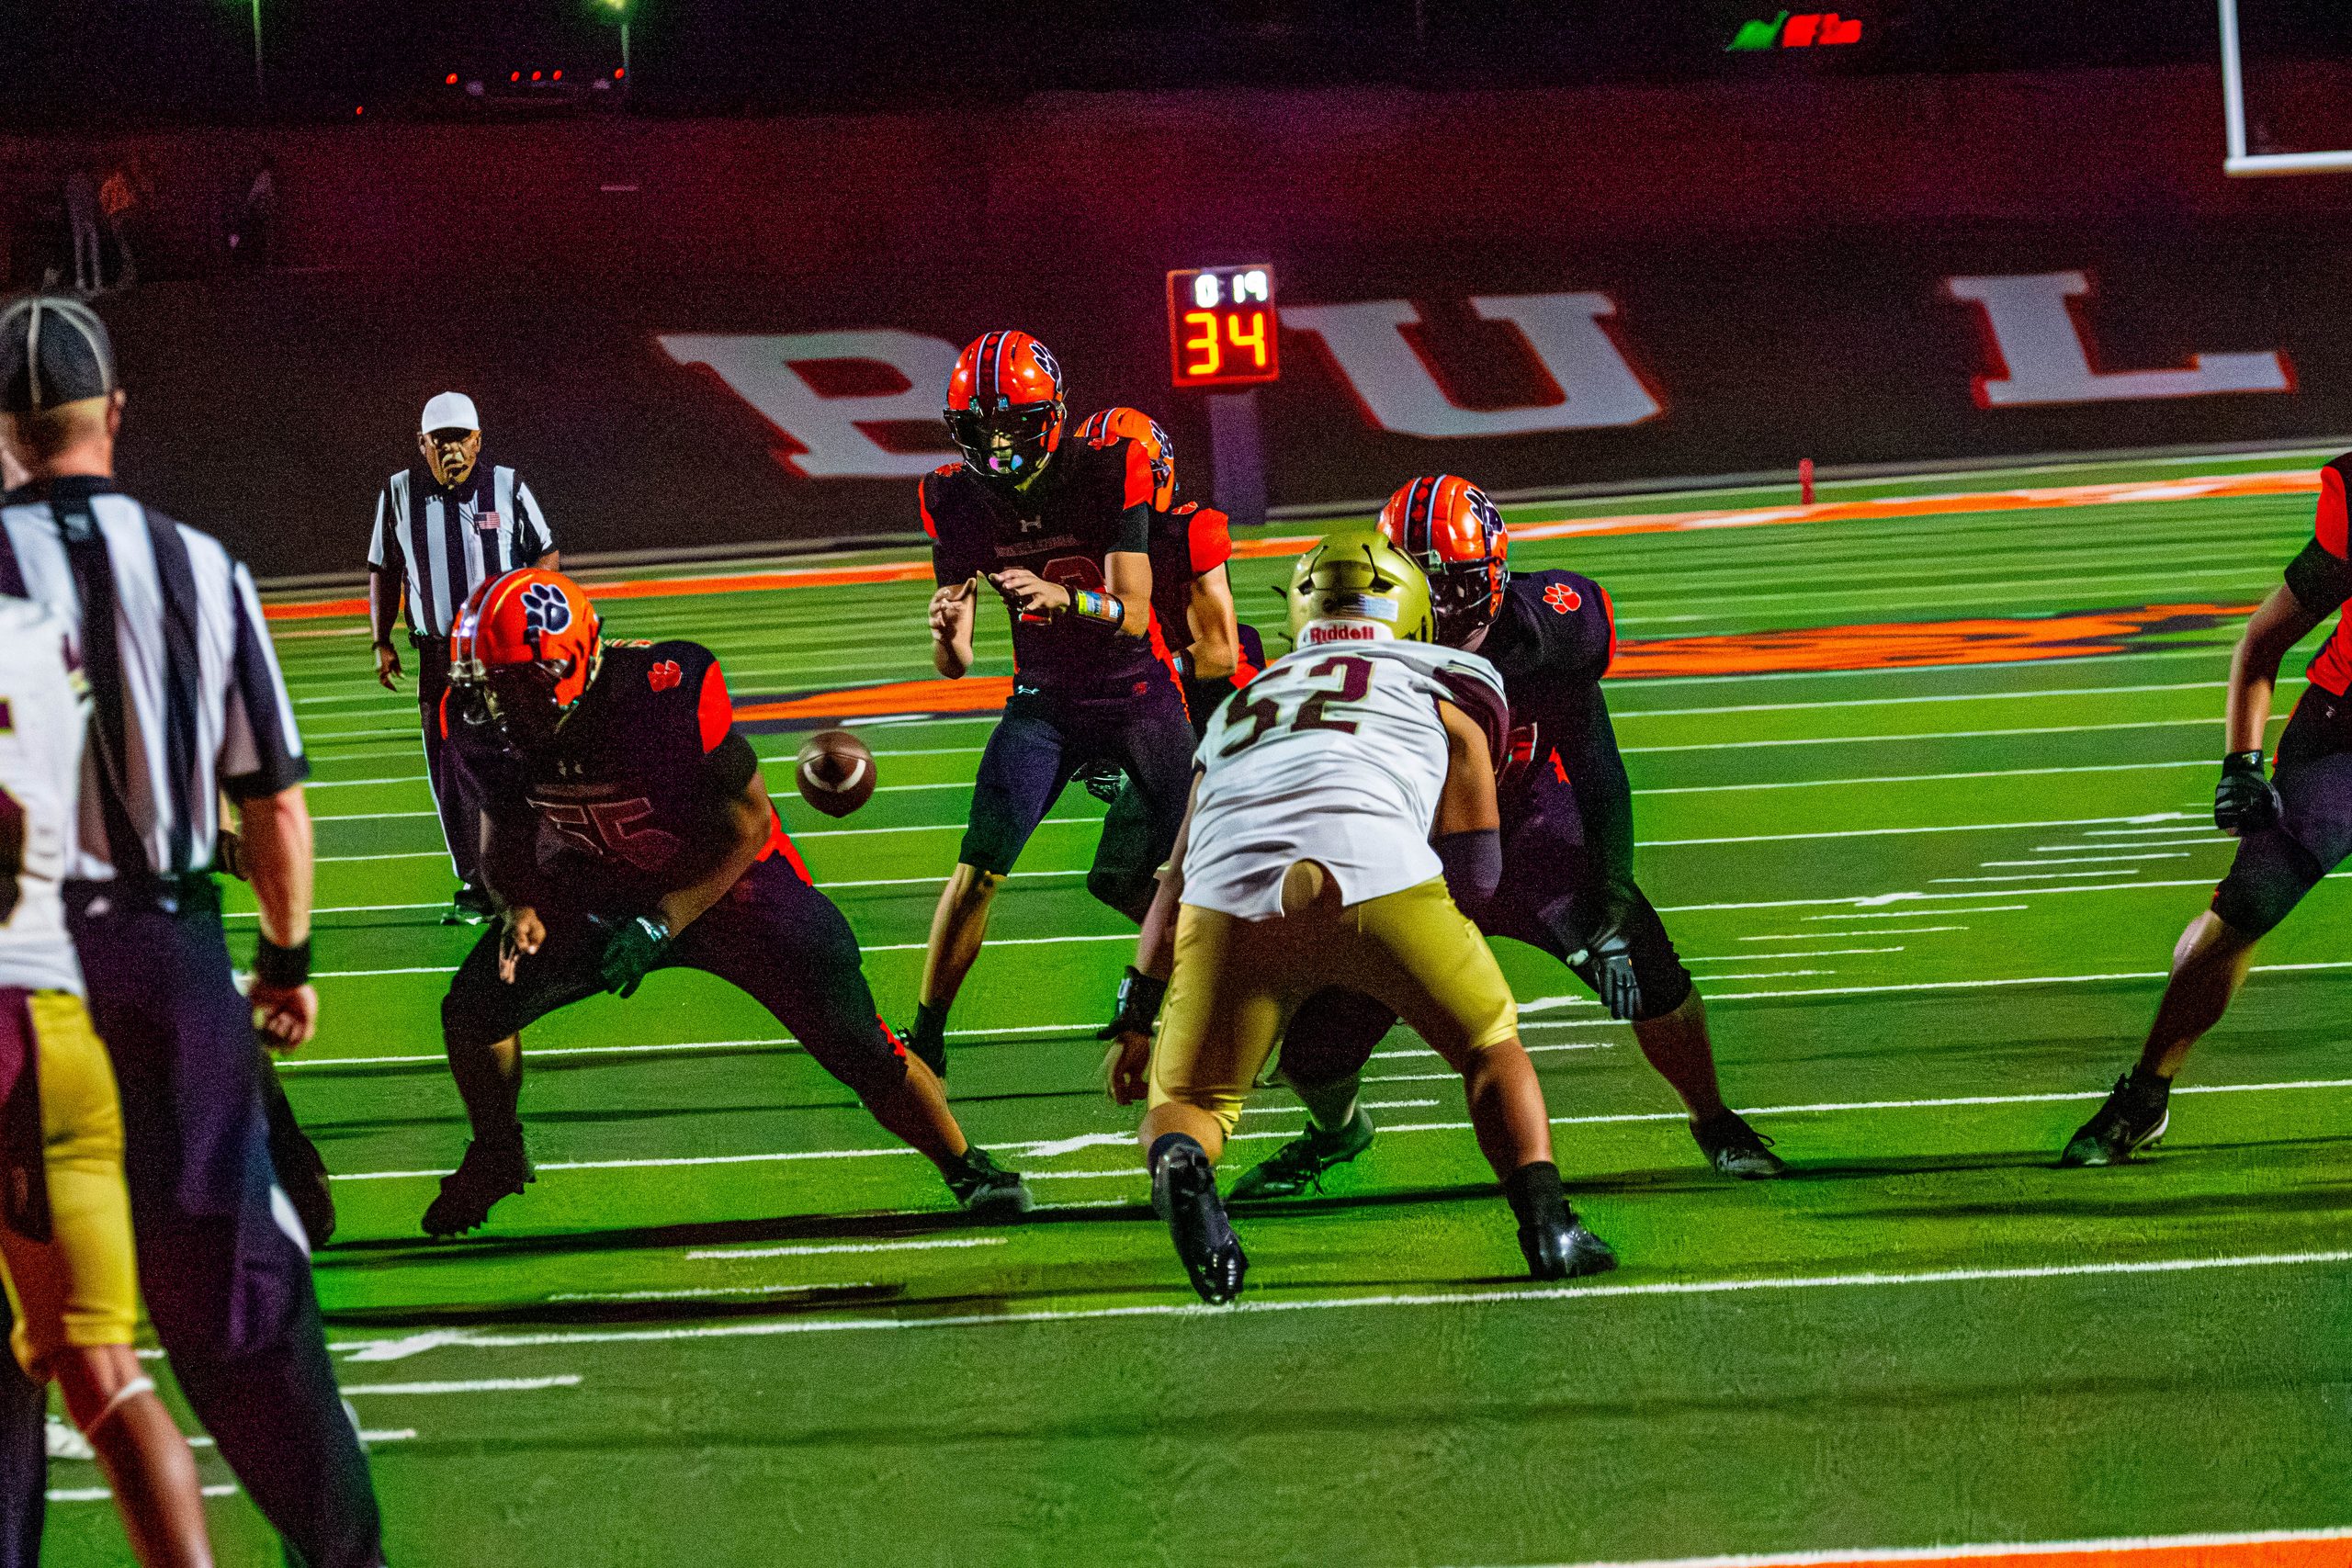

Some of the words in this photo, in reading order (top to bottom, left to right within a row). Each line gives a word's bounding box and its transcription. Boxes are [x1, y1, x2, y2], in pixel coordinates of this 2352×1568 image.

[1185, 311, 1266, 376] 34
[1309, 624, 1374, 644] Riddell
[1220, 655, 1375, 758] 52
